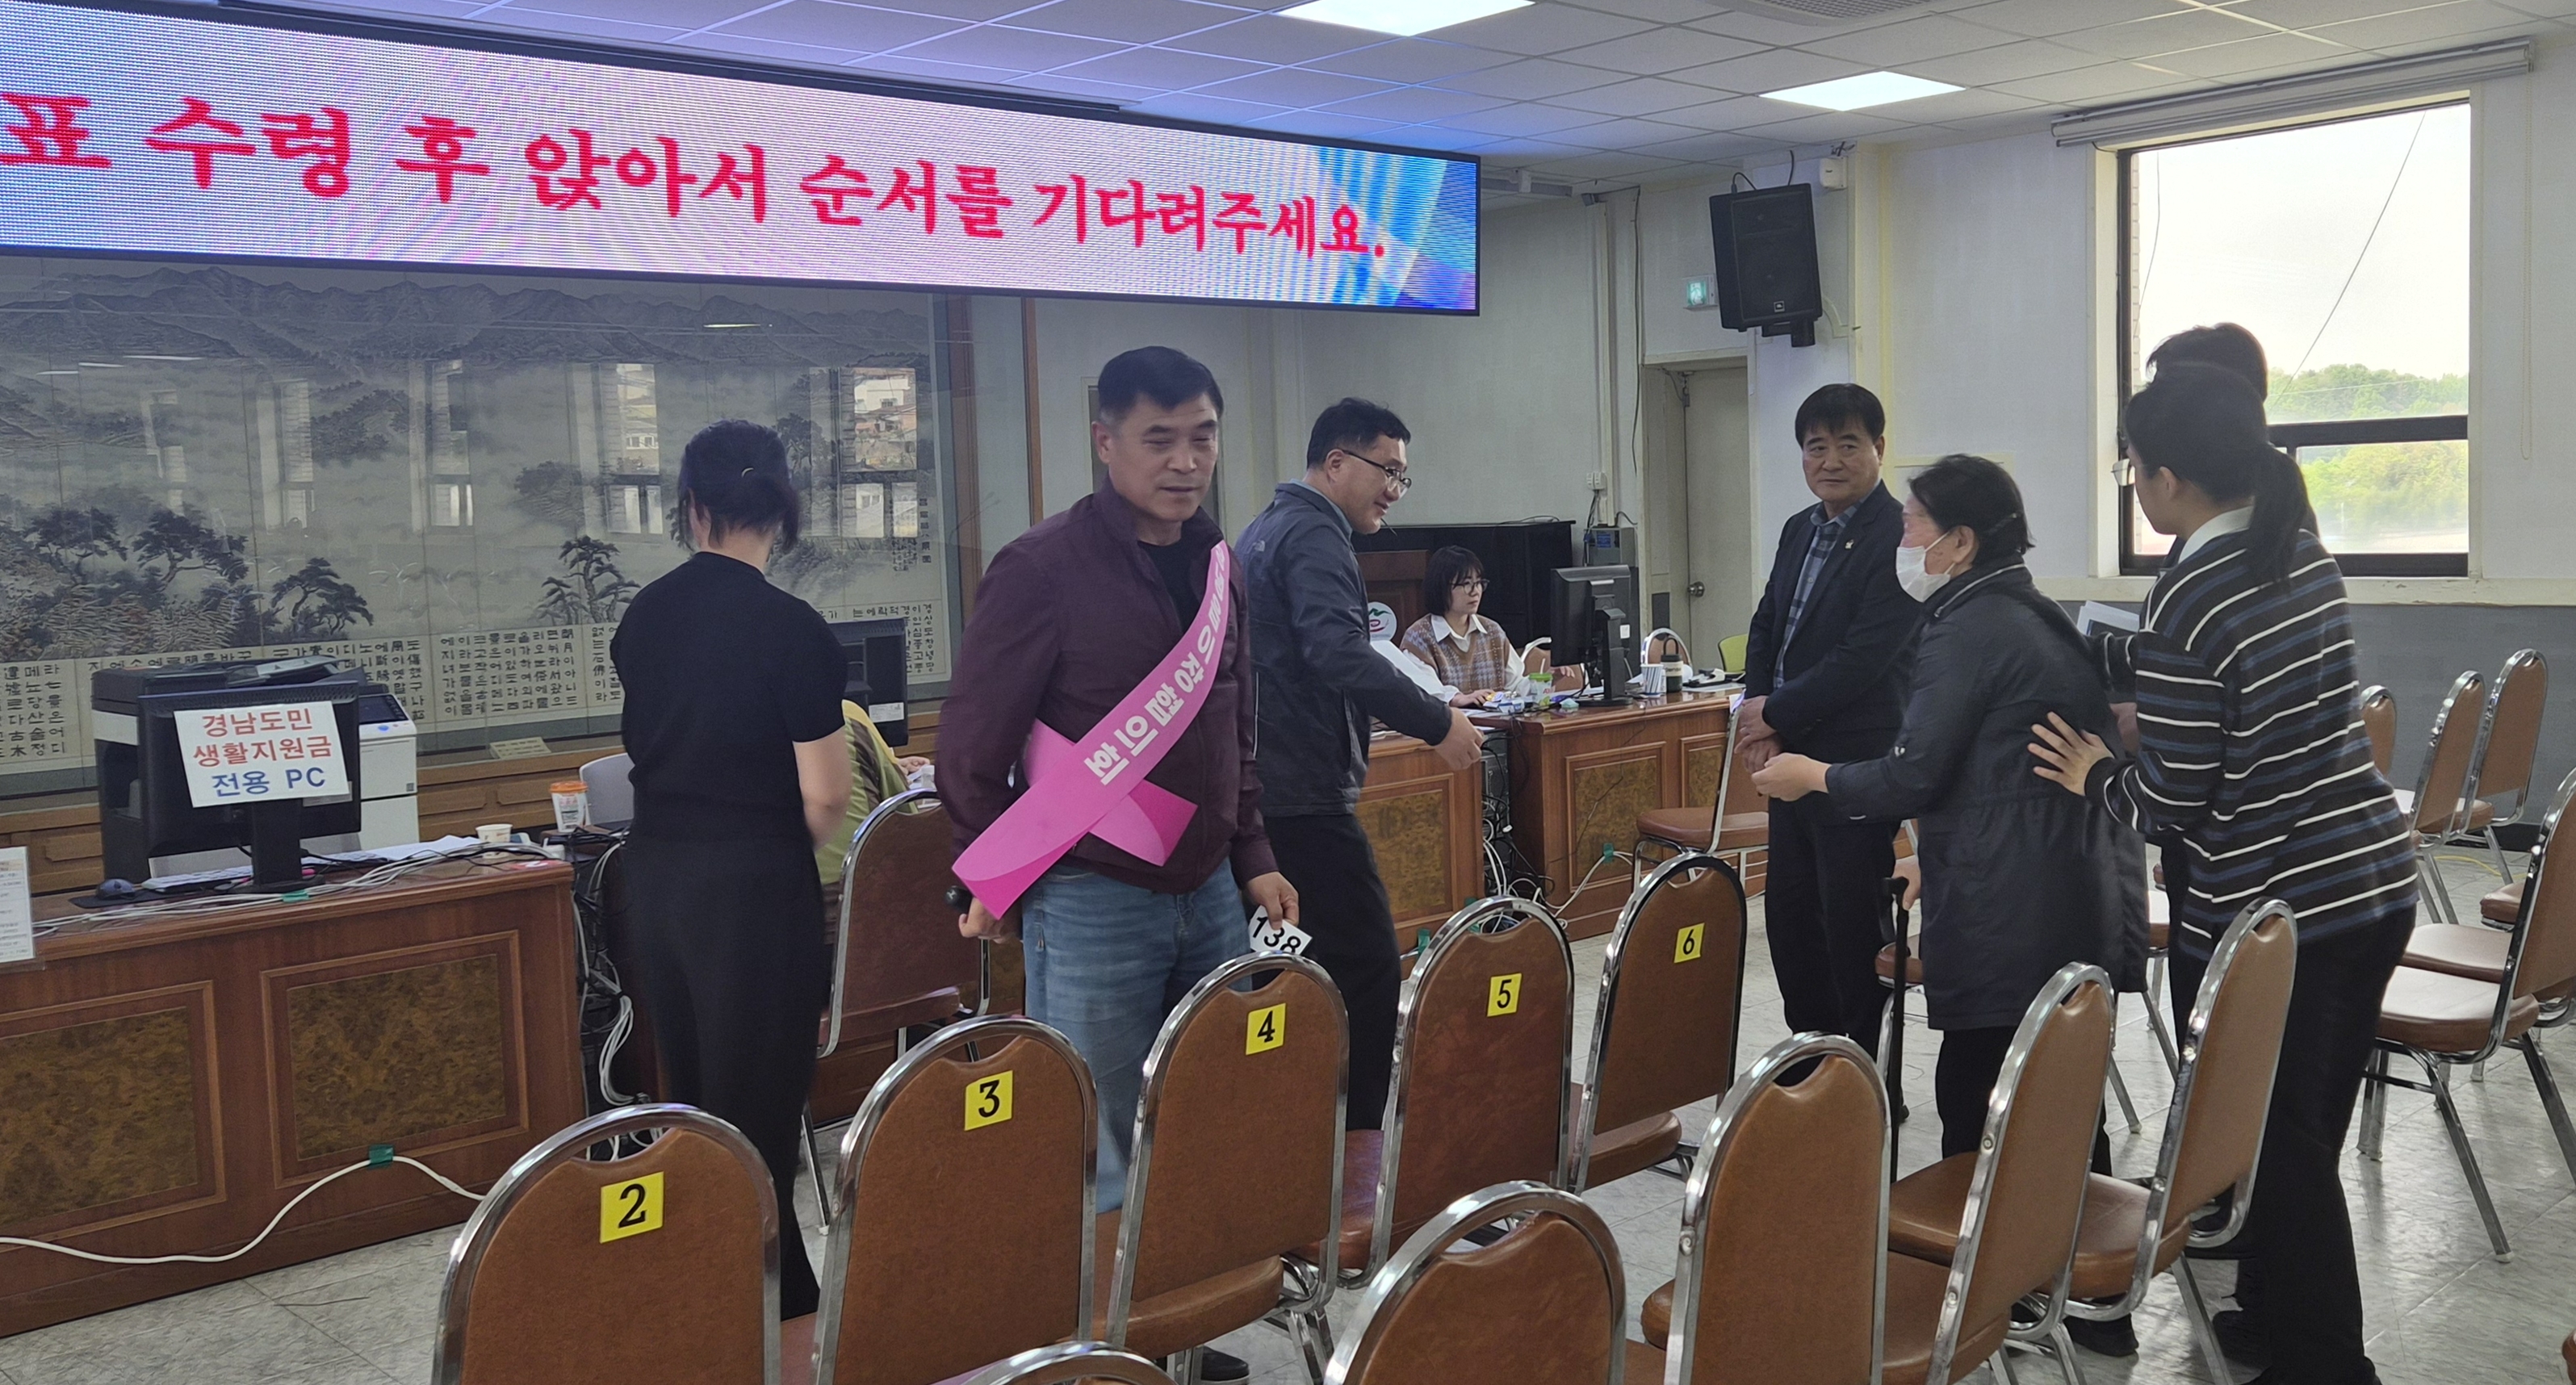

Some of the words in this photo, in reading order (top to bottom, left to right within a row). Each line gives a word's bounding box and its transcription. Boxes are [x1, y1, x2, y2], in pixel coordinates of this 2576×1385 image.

[145, 97, 352, 198] 수령
[395, 115, 490, 204] 후
[524, 128, 768, 224] 앉아서
[799, 154, 1014, 240] 순서를
[1033, 174, 1385, 258] 기다려주세요.
[202, 708, 313, 738] 경남도민
[193, 736, 332, 768] 생활지원금
[212, 771, 270, 797] 전용
[285, 767, 326, 789] PC
[1252, 916, 1301, 953] 138
[1682, 929, 1695, 956] 6
[1496, 979, 1513, 1009] 5
[1257, 1011, 1275, 1043] 4
[978, 1079, 1000, 1118] 3
[618, 1183, 647, 1228] 2
